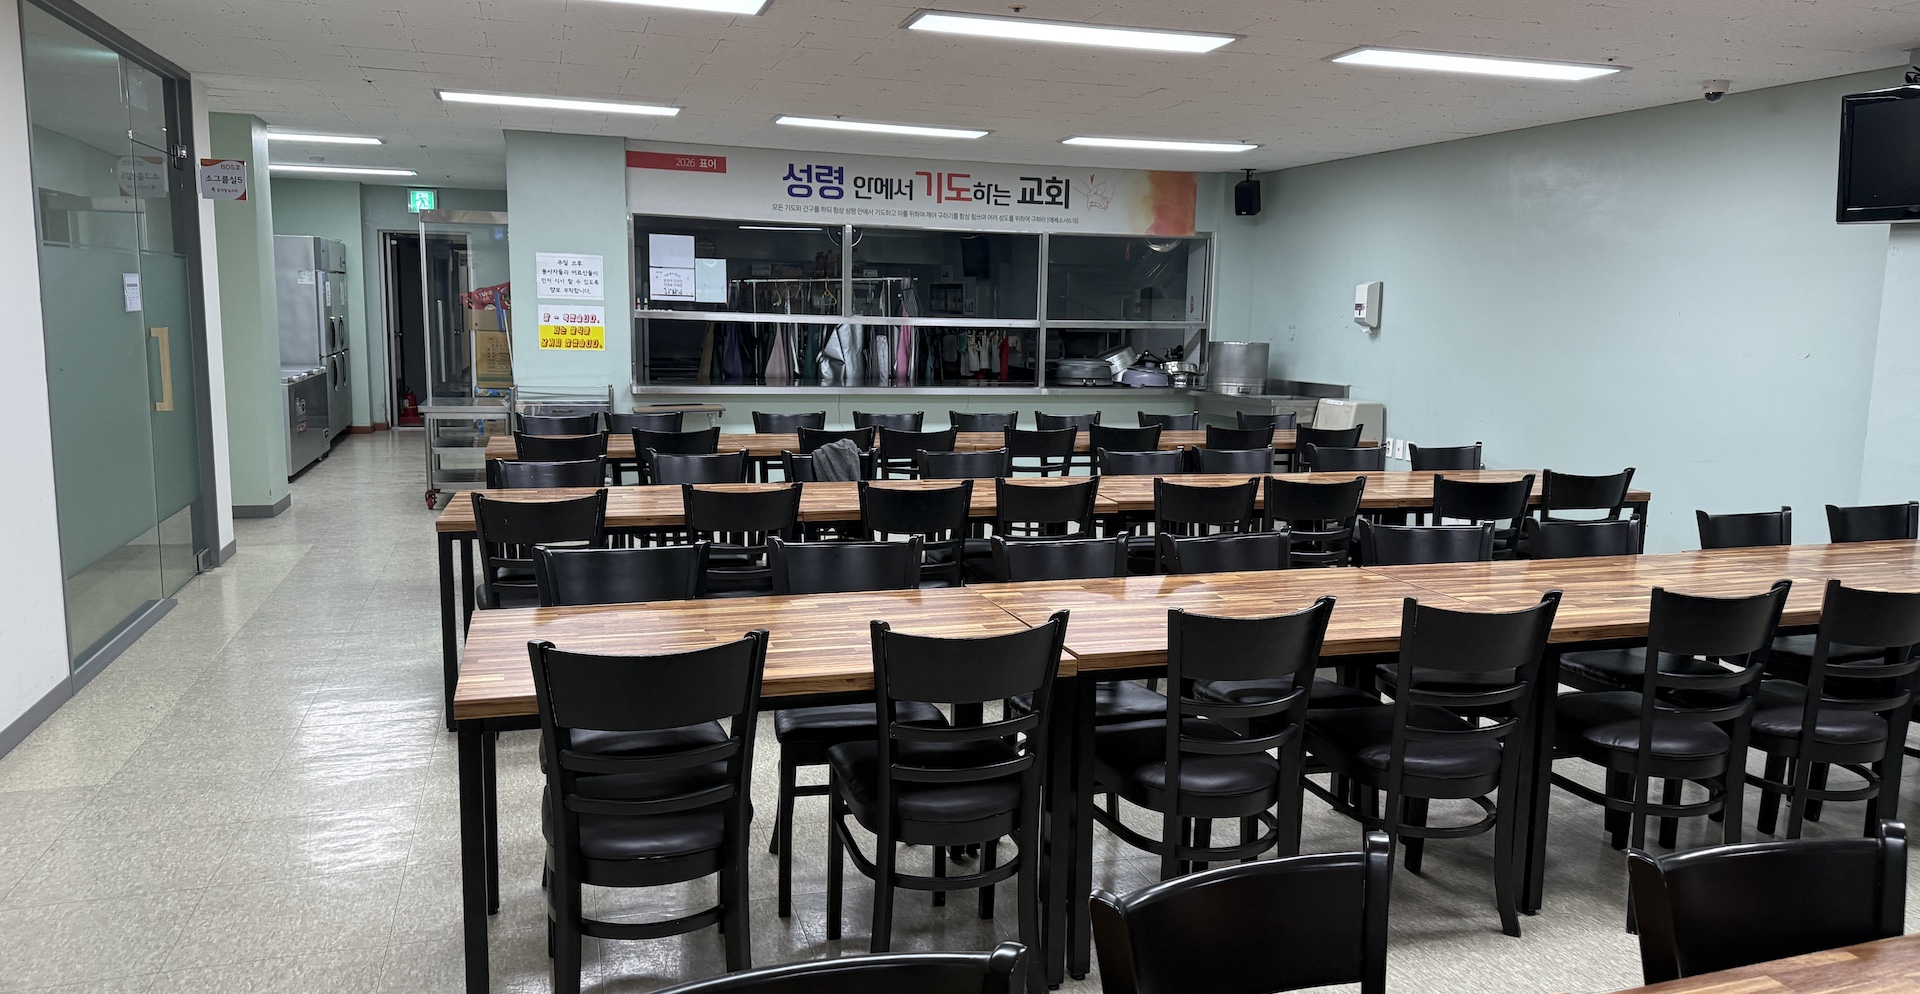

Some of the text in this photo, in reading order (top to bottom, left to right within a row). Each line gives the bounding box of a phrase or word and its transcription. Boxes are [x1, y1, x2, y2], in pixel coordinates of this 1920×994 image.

[676, 158, 716, 169] 2026 표어
[782, 163, 1070, 209] 성령 안에서 기도하는 교회
[785, 204, 800, 212] 기도와
[803, 205, 820, 213] 간구를
[846, 207, 856, 215] 성령
[858, 208, 874, 216] 안에서
[875, 208, 896, 216] 기도하고
[898, 210, 908, 218] 이를
[938, 212, 958, 220] 구하기를
